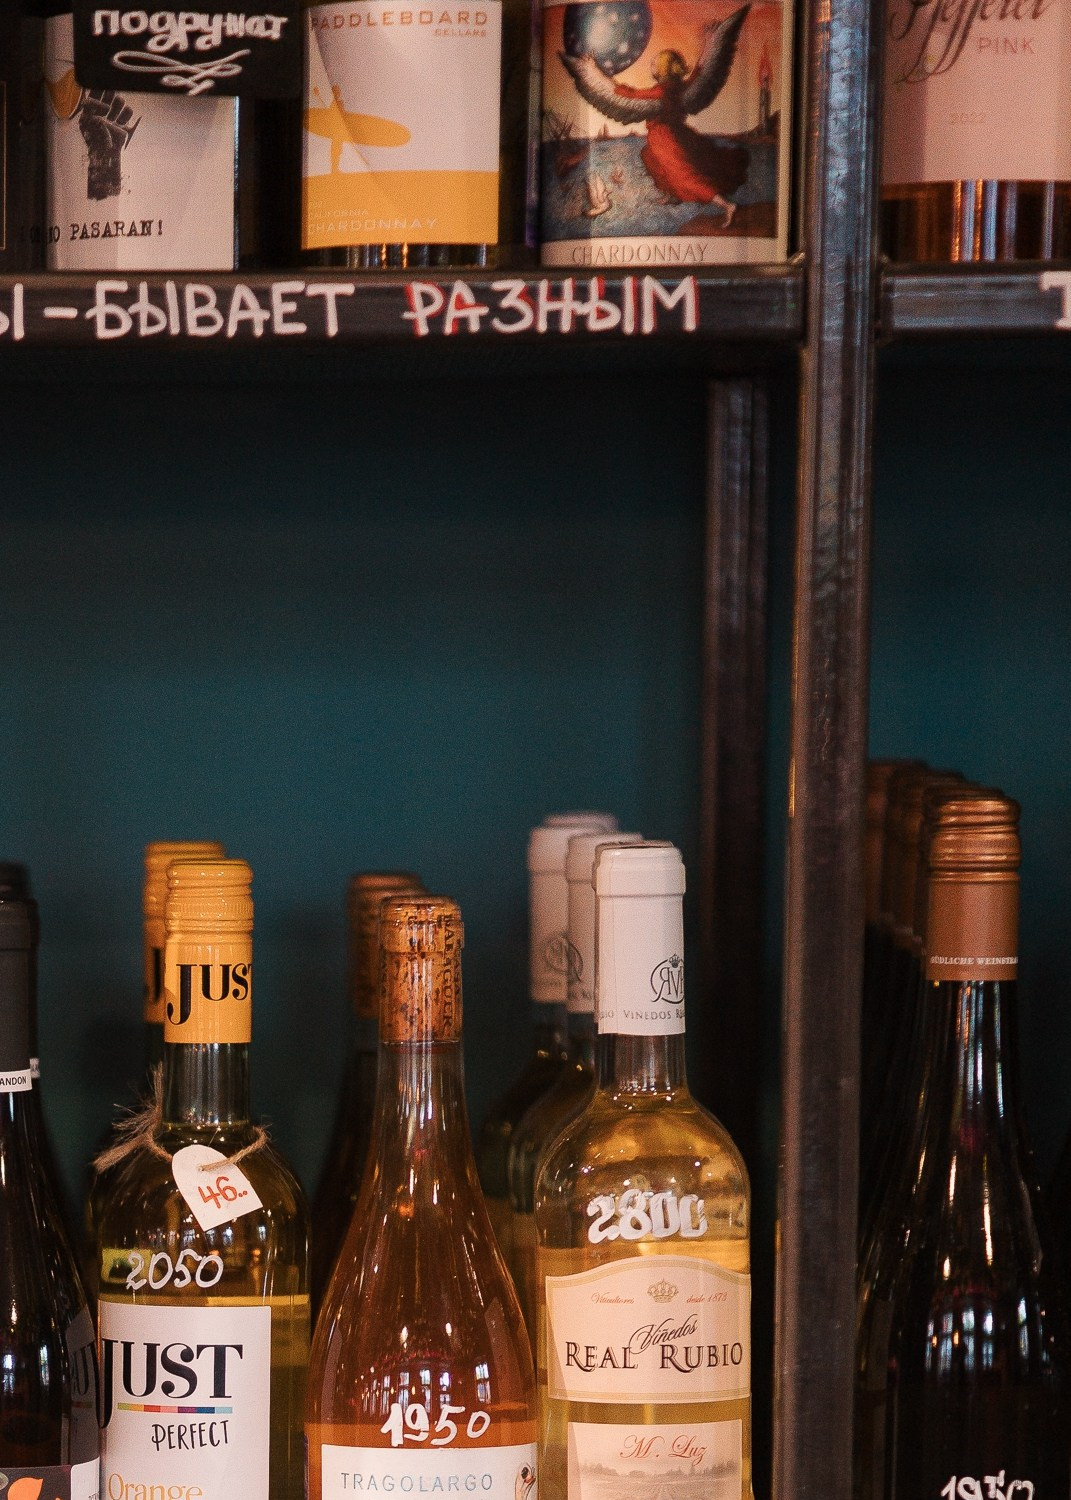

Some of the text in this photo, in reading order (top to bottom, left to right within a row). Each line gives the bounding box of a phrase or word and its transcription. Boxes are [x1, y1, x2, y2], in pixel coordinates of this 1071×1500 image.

[311, 10, 488, 31] PADDLEBOARD
[978, 37, 1035, 55] PINK
[70, 219, 163, 241] PASARAN!
[572, 243, 710, 264] CHARDONNAY
[402, 276, 701, 338] РАЗНЫМ
[586, 1188, 709, 1244] 2800
[126, 1249, 224, 1290] 2050
[630, 1313, 698, 1354] Viñedos
[565, 1341, 743, 1374] REAL RUBIO
[100, 1338, 244, 1429] JUST
[151, 1419, 230, 1451] PERFECT
[380, 1402, 491, 1447] 1950
[671, 1434, 709, 1466] Luz
[340, 1472, 494, 1493] TRAGOLARGO
